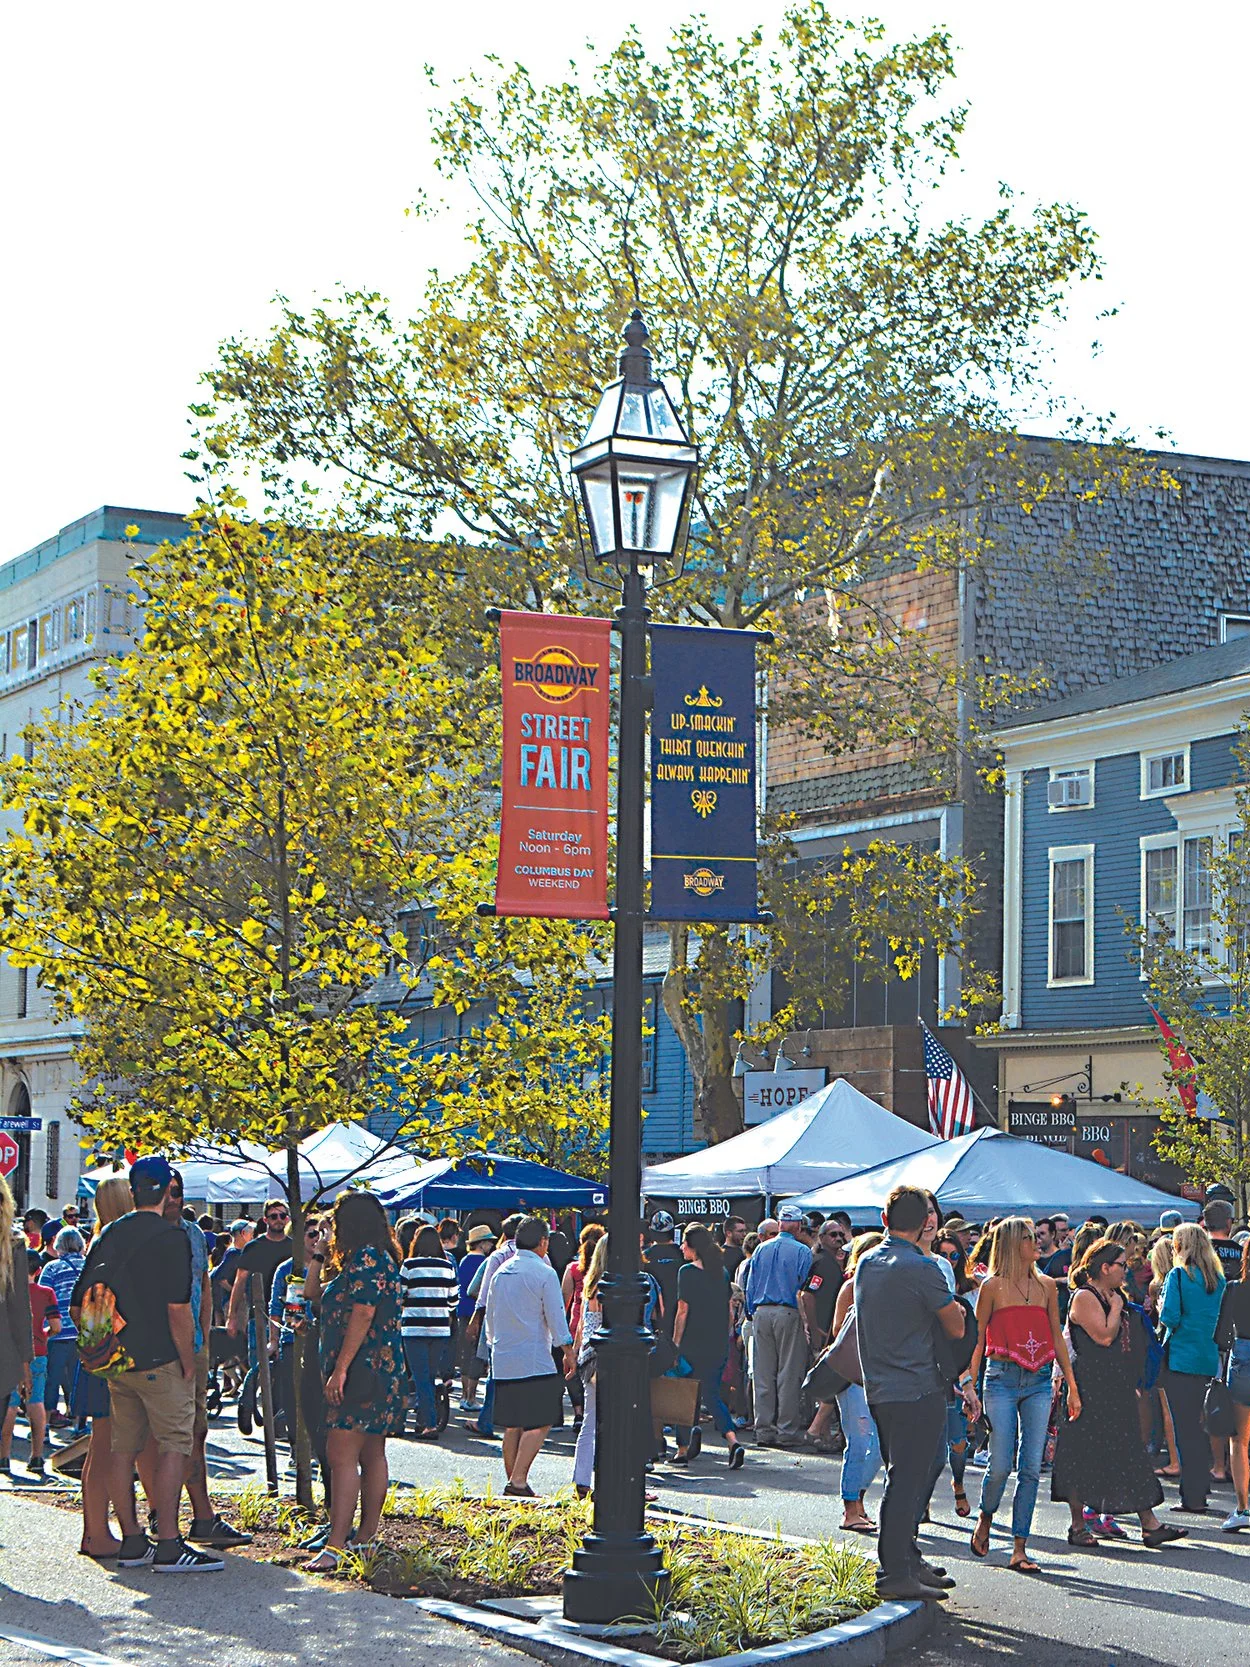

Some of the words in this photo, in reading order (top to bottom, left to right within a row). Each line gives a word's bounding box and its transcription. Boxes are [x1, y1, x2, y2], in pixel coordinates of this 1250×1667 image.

[514, 662, 598, 686] BROADWAY
[520, 712, 592, 742] STREET
[671, 713, 737, 733] LIP-SMACKIN'
[659, 738, 692, 756] THIRST
[696, 740, 748, 758] QUENCHIN'
[520, 743, 592, 791] FAIR
[656, 763, 695, 782] ALWAYS
[699, 766, 751, 784] HAPPENIN'
[528, 828, 582, 844] Saturday
[519, 841, 551, 853] Noon
[563, 843, 591, 856] 6pm
[514, 865, 571, 877] COLUMBUS
[573, 868, 594, 878] DAY
[528, 878, 580, 889] WEEKEND
[684, 877, 724, 887] BROADWAY
[760, 1087, 809, 1107] HOPE
[1011, 1112, 1048, 1126] BINGE
[1051, 1112, 1075, 1126] BBQ
[1082, 1126, 1110, 1142] BBQ
[677, 1199, 707, 1214] BINGE
[709, 1199, 730, 1217] BBQ
